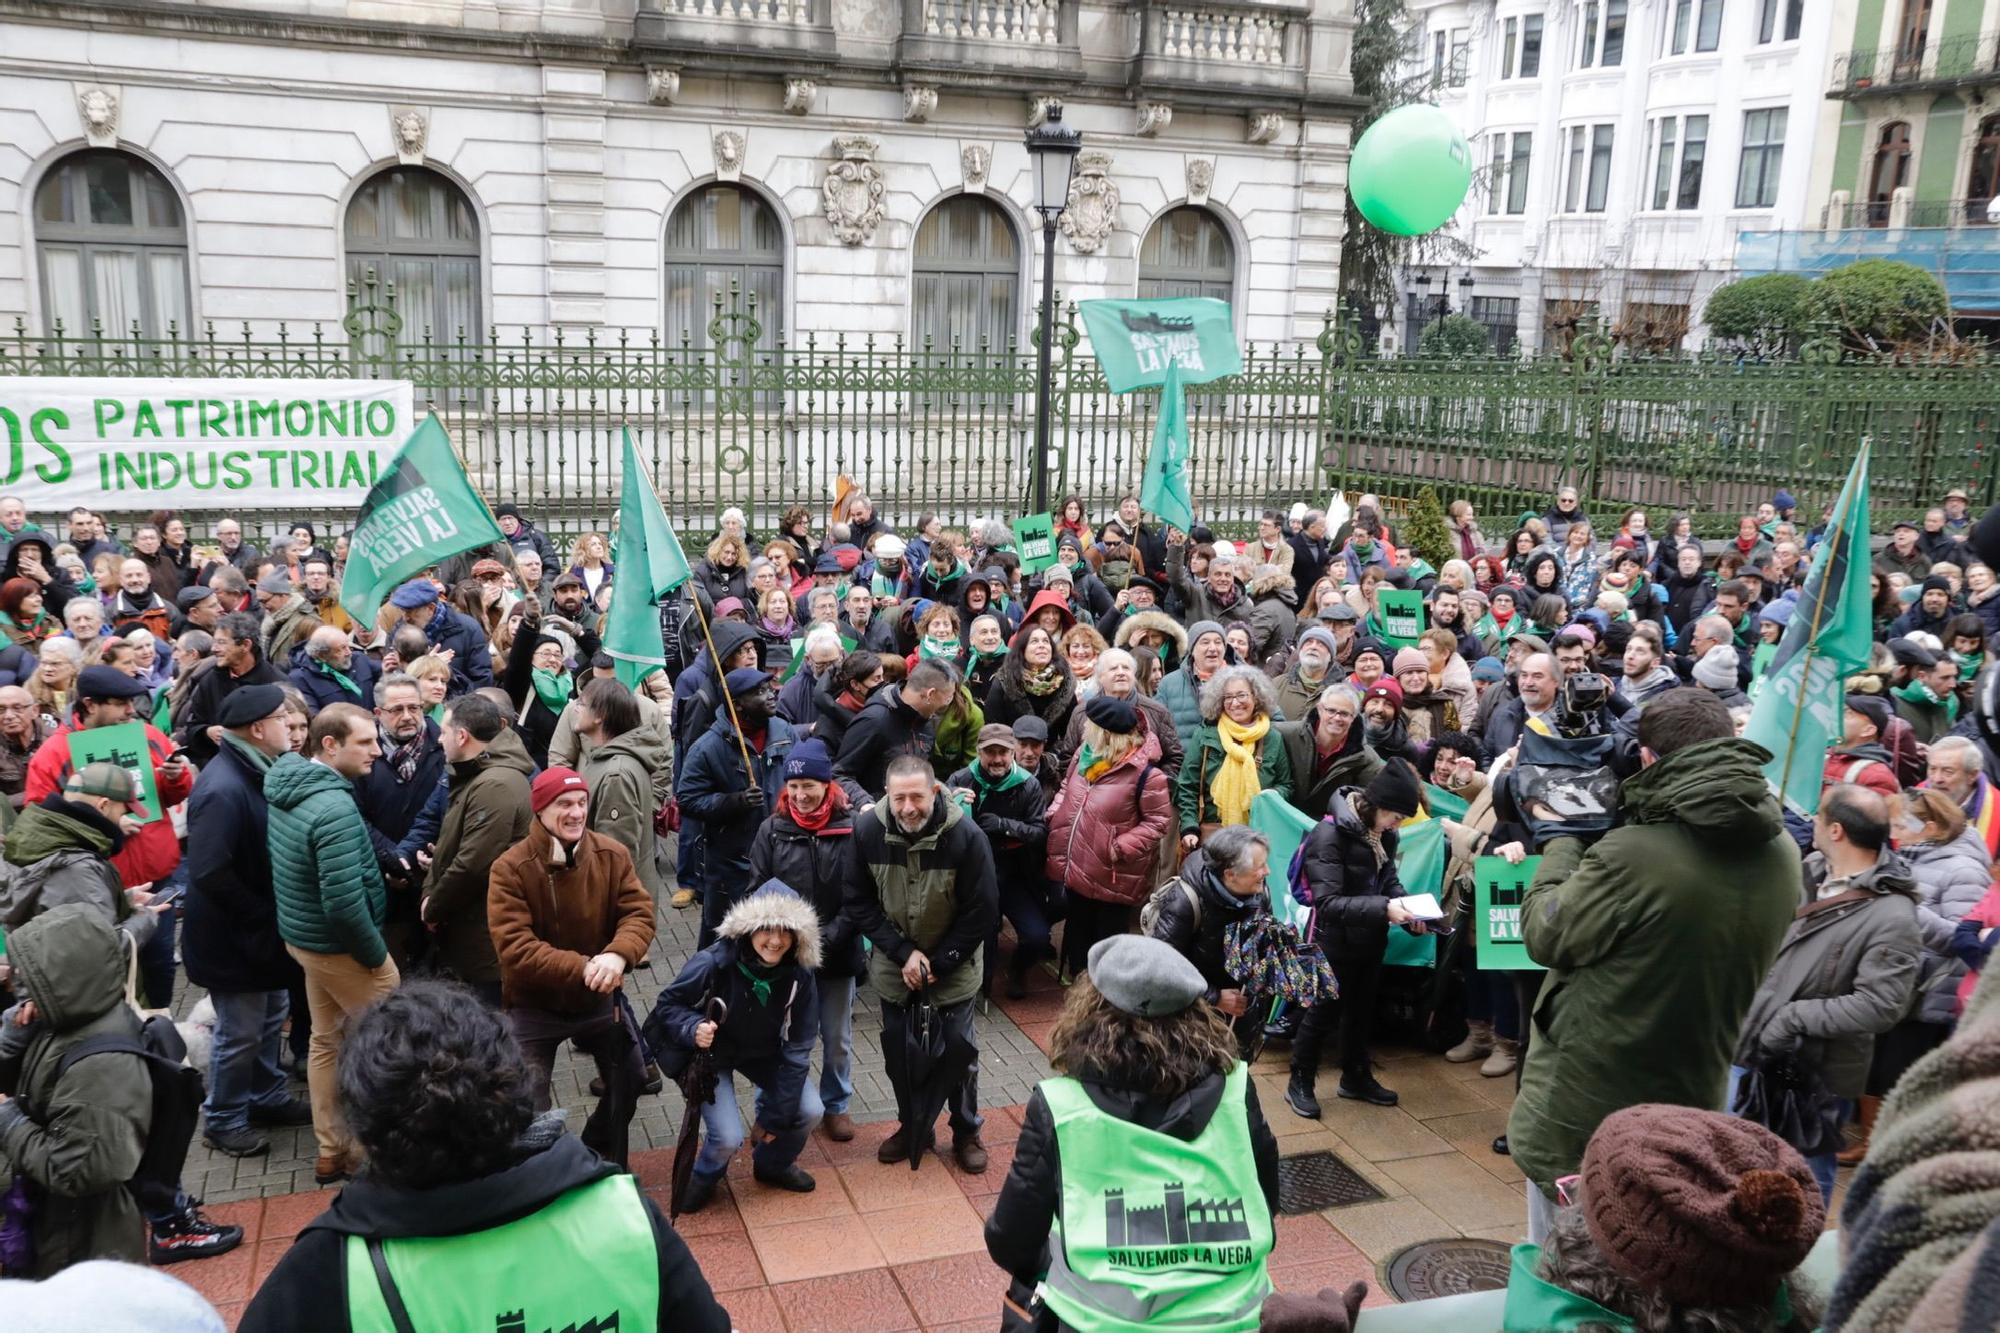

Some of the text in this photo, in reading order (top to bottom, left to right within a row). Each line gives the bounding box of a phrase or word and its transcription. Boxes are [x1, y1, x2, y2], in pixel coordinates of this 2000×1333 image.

[1130, 332, 1200, 351] SALMOS
[1136, 349, 1161, 374] LA
[94, 399, 396, 438] PATRIMONIO
[1490, 922, 1508, 938] LA
[1108, 1244, 1252, 1268] SALVEMOS LA VEGA
